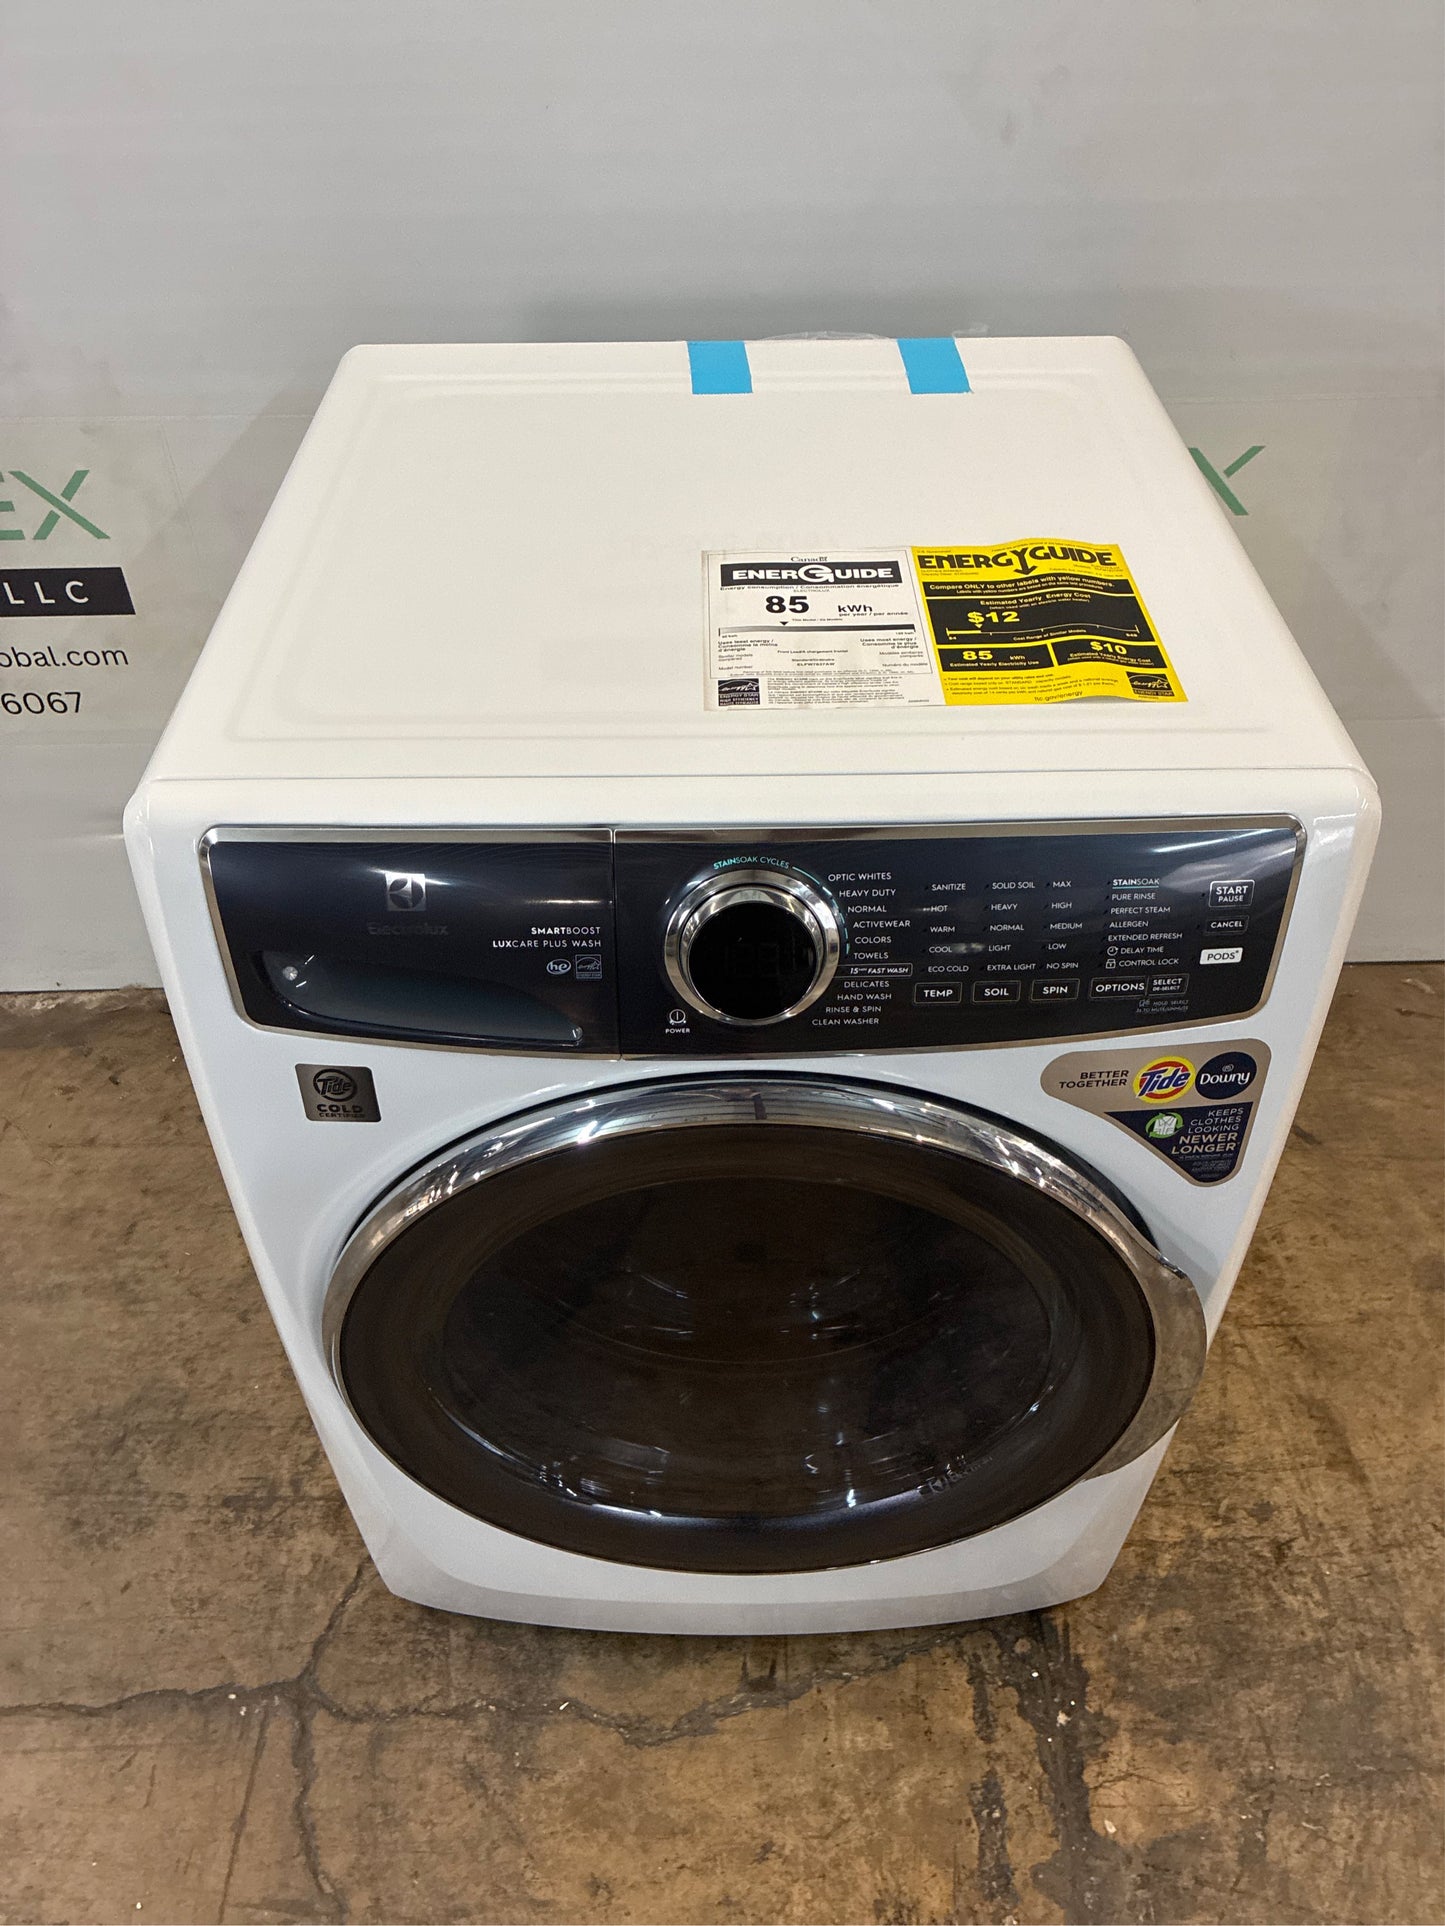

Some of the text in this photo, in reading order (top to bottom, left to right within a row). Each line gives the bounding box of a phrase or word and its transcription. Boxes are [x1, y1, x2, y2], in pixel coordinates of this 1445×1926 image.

[732, 564, 894, 583] ENERGUIDE
[2, 581, 89, 605] LLC
[765, 595, 873, 613] 85 kWh
[1018, 595, 1042, 604] Yearly
[967, 611, 1020, 624] $12
[1089, 641, 1127, 655] $10
[962, 650, 994, 661] 85
[1, 691, 81, 714] 6067
[713, 856, 790, 870] STAINSOAK CYCLES
[827, 872, 892, 882] OPTIC WHITES
[992, 881, 1036, 890] SOLID SOIL
[1112, 878, 1160, 886] STAINSOAK
[931, 883, 967, 891] SANITIZE
[1216, 886, 1249, 895] START
[839, 888, 897, 898] HEAVY DUTY
[1133, 892, 1156, 900] RINSE
[847, 905, 887, 914] NORMAL
[930, 905, 948, 913] HOT
[991, 903, 1018, 911] HEAVY
[1110, 906, 1171, 915] PERFECT STEAM
[853, 920, 911, 929] ACTIVEWEAR
[989, 924, 1025, 932] NORMAL
[1050, 922, 1083, 930] MEDIUM
[1109, 920, 1149, 928] ALLERGEN
[1210, 920, 1244, 929] CANCEL
[531, 926, 601, 935] SMARTBOOST
[930, 925, 956, 933] WARM
[854, 935, 892, 945] COLORS
[1108, 932, 1183, 942] EXTENDED REFRESH
[492, 939, 602, 948] LUXCARE PLUS WASH
[988, 944, 1012, 952] LIGHT
[928, 946, 953, 954] COOL
[1120, 947, 1145, 955] DELAY
[853, 951, 890, 960] TOWELS
[987, 963, 1037, 972] EXTRA LIGHT
[1118, 958, 1180, 968] CONTROL LOCK
[927, 965, 970, 973] ECO COLD
[843, 980, 890, 989] DELICATES
[1152, 978, 1183, 986] SELECT
[984, 988, 1010, 996] SOIL
[1042, 986, 1069, 995] SPIN
[1095, 982, 1146, 993] OPTIONS
[837, 992, 892, 1001] HAND WASH
[923, 989, 954, 998] TEMP
[825, 1005, 882, 1014] RINSE & SPIN
[812, 1017, 880, 1027] CLEAN WASHER
[1080, 1070, 1130, 1080] BETTER
[1200, 1070, 1251, 1085] Downy
[317, 1075, 352, 1096] Tide
[1059, 1078, 1128, 1089] TOGETHER
[1136, 1066, 1191, 1099] Tide
[316, 1103, 363, 1113] COLD
[1208, 1107, 1244, 1117] KEEPS
[1190, 1116, 1242, 1126] CLOTHES
[1188, 1123, 1240, 1134] LOOKING
[1179, 1132, 1238, 1144] NEWER
